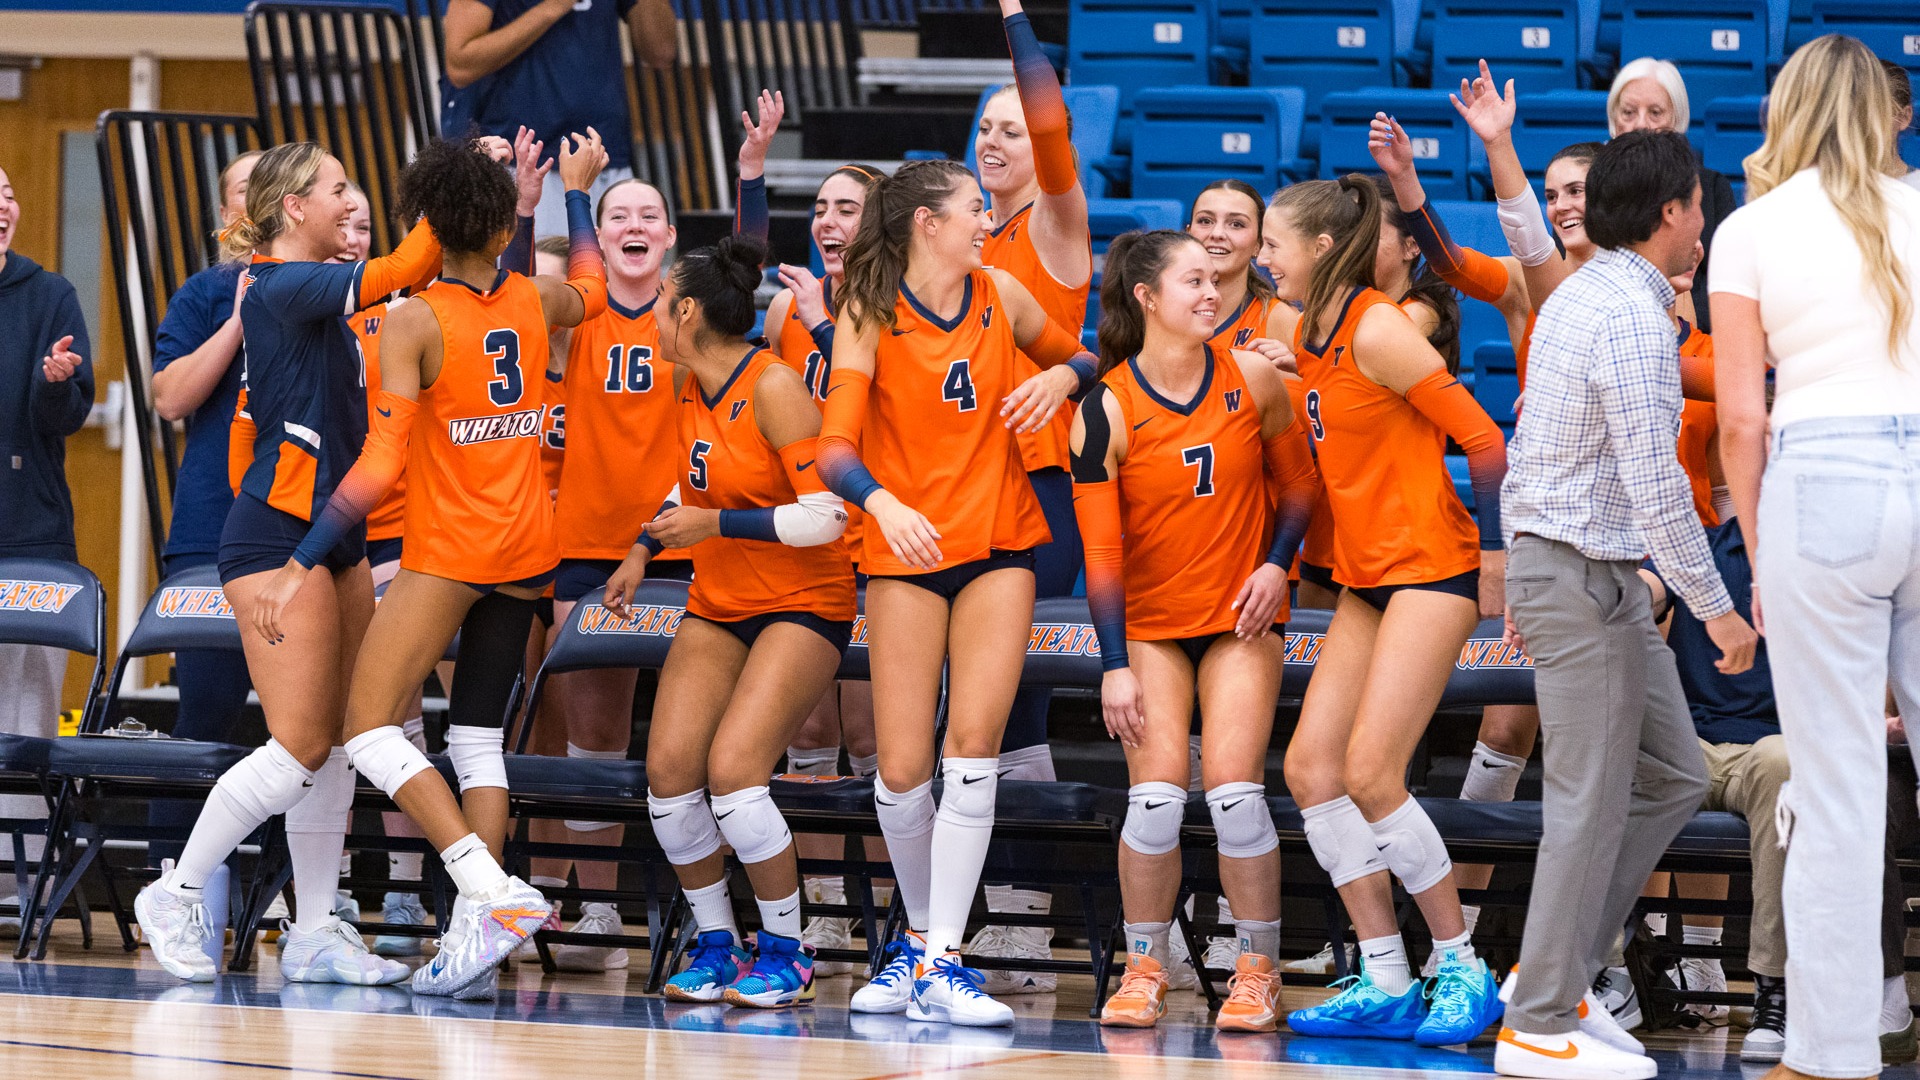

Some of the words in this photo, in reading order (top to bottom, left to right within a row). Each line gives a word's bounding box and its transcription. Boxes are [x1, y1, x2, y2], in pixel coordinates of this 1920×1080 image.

[365, 316, 381, 336] W
[1233, 327, 1255, 348] W
[483, 328, 523, 408] 3
[604, 343, 654, 393] 16
[942, 358, 978, 413] 4
[1223, 388, 1242, 413] W
[1305, 389, 1325, 441] 9
[688, 438, 713, 492] 5
[1181, 442, 1215, 497] 7
[157, 587, 236, 619] WHEA
[578, 604, 686, 636] WHEATO
[1456, 638, 1535, 670] WHEA
